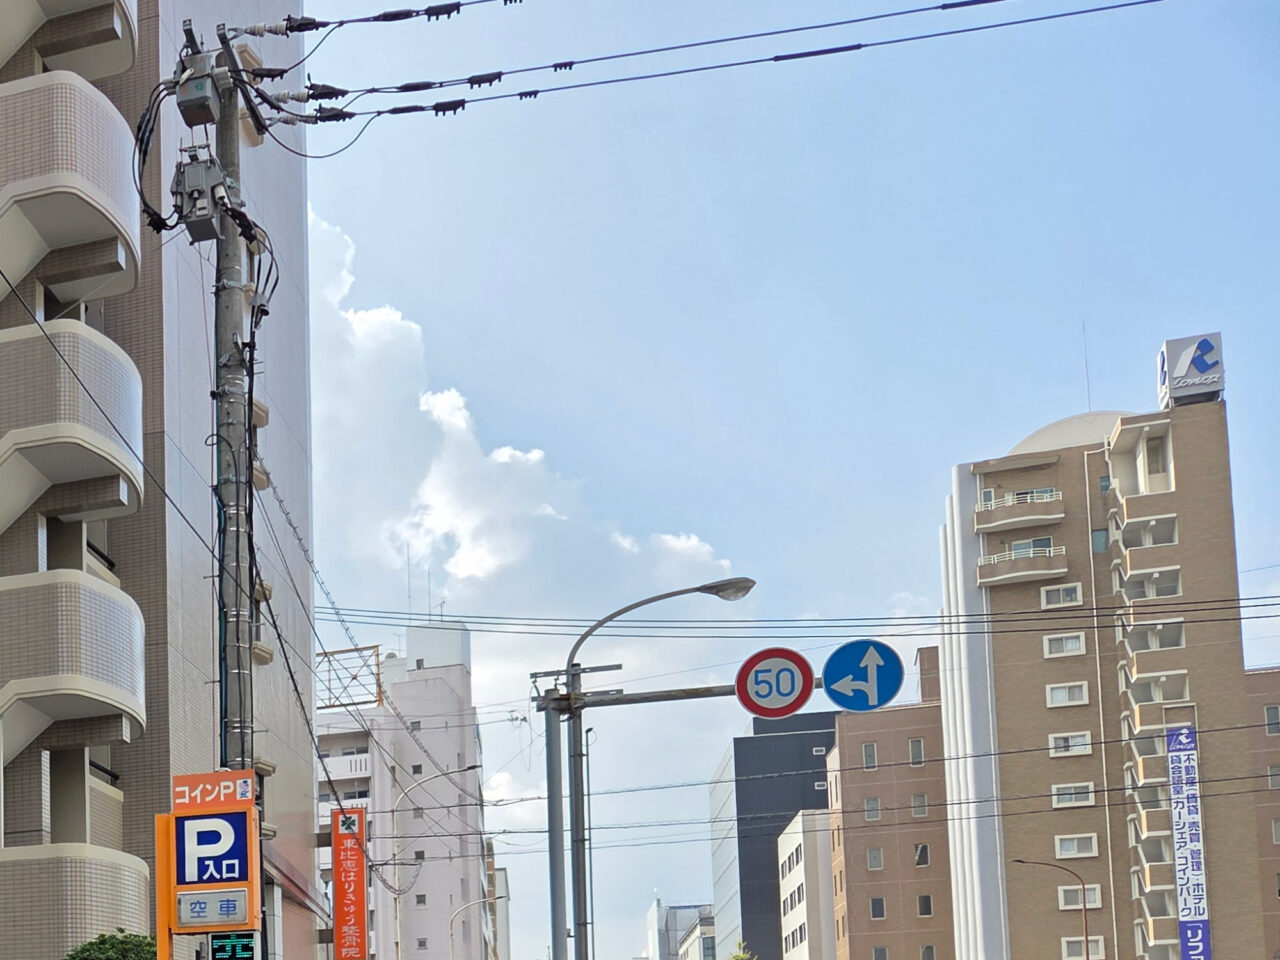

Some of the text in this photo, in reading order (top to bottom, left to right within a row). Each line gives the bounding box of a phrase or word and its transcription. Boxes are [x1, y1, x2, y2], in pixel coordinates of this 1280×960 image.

[754, 667, 796, 699] 50
[175, 781, 235, 805] コインP
[184, 818, 235, 882] P
[202, 859, 240, 881] 入口
[189, 898, 238, 919] 空車
[339, 838, 361, 958] 東比恵はりきゅう整骨院
